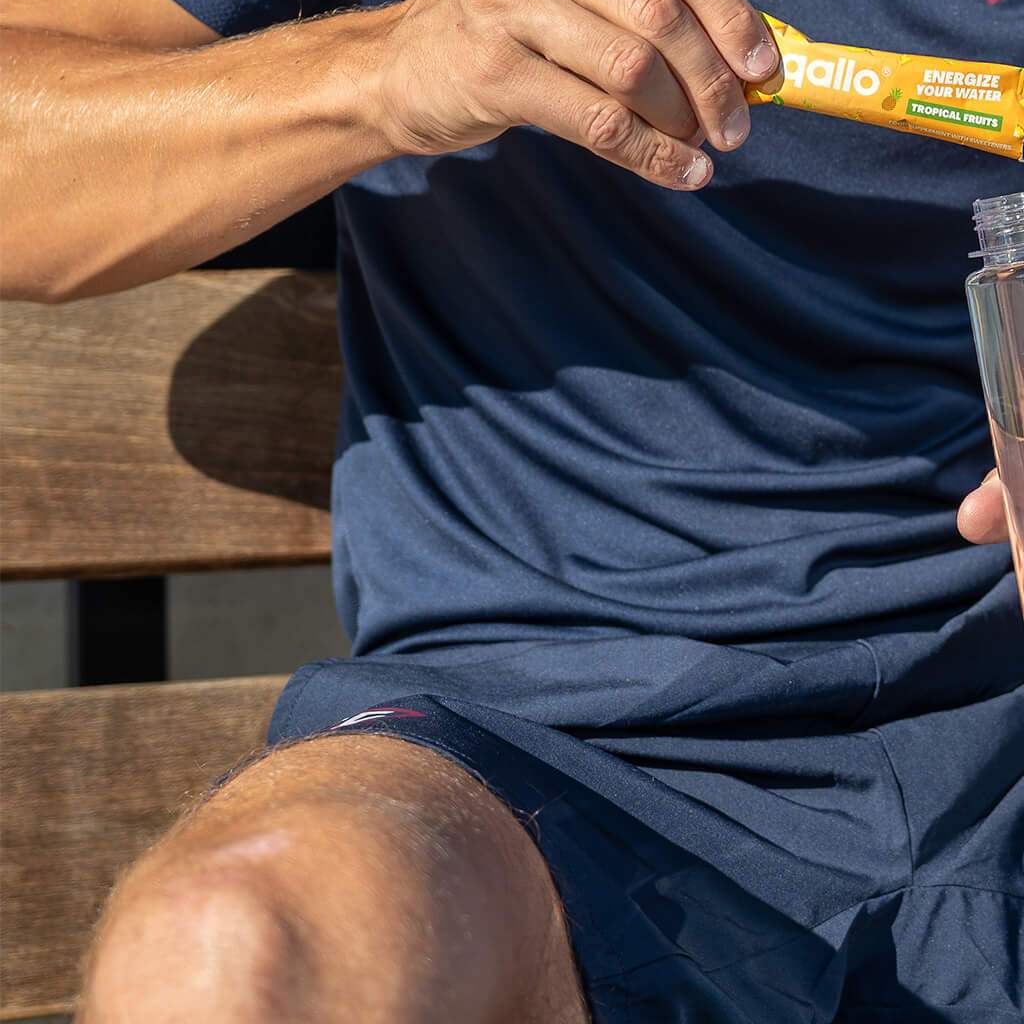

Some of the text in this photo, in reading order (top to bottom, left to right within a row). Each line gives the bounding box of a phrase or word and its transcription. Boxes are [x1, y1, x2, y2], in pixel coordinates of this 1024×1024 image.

[783, 53, 880, 96] qallo
[923, 69, 1001, 88] ENERGIZE
[916, 84, 1002, 102] YOUR WATER
[911, 103, 961, 120] TROPICAL
[963, 113, 999, 128] FRUITS
